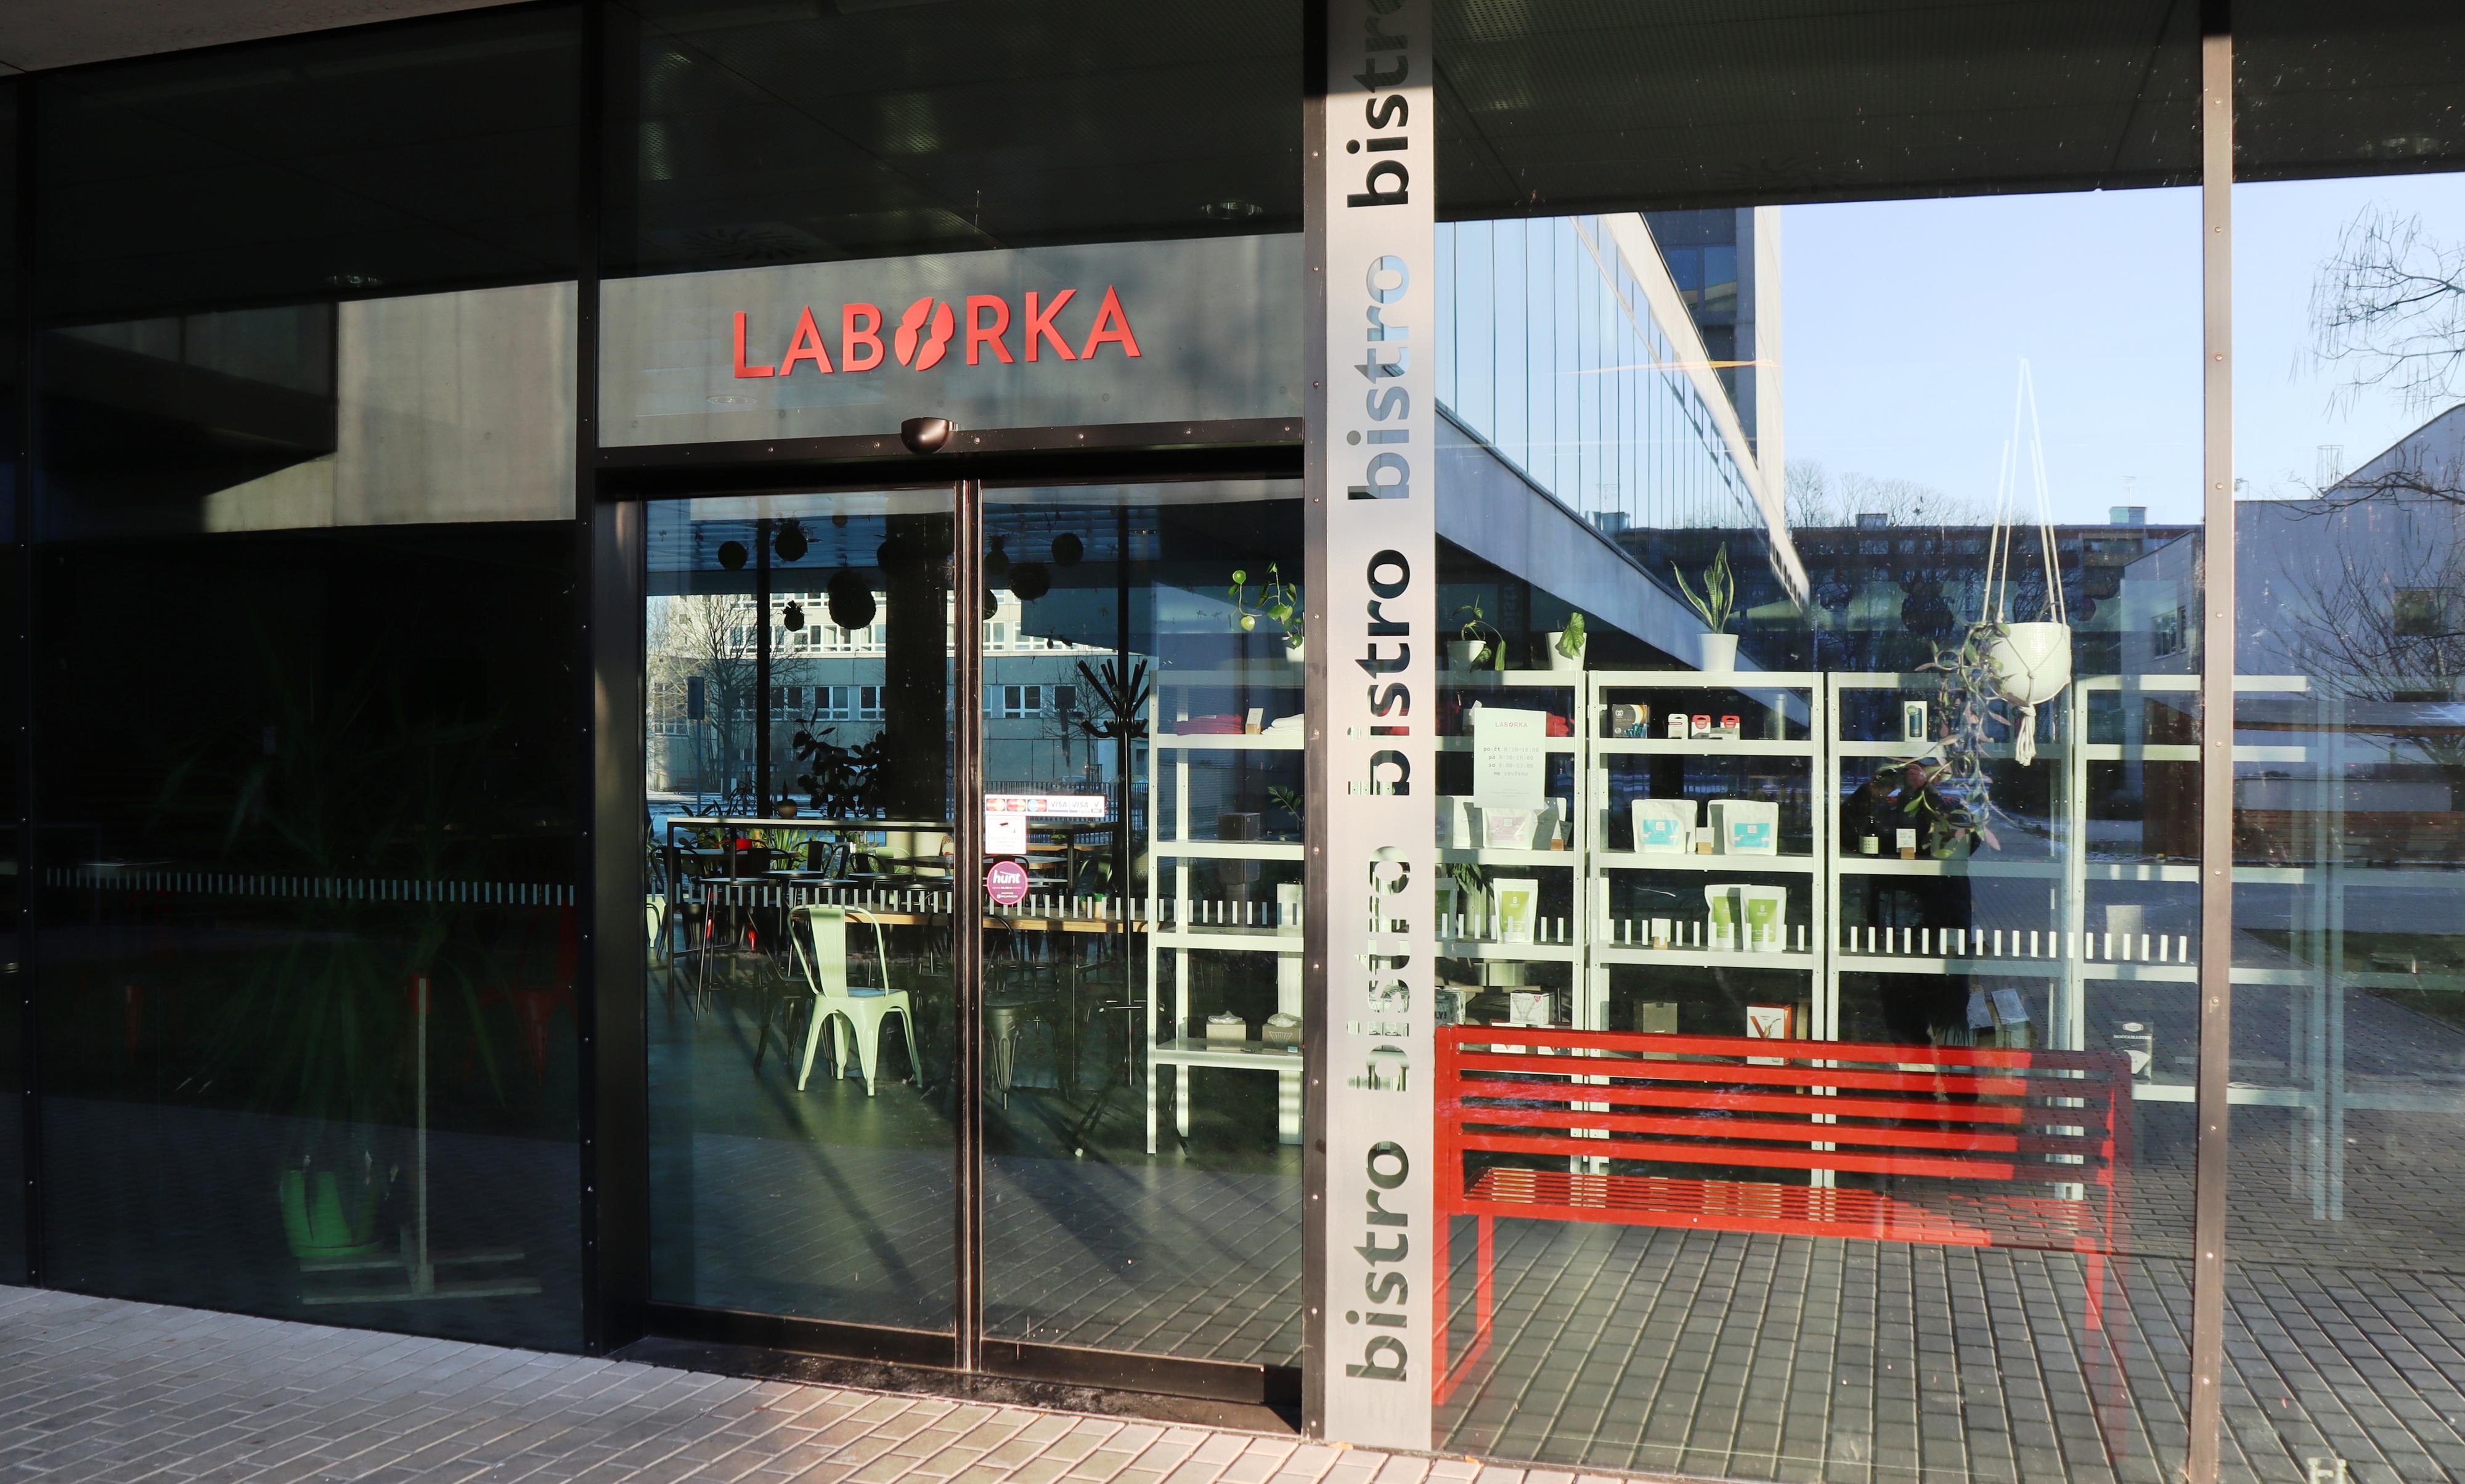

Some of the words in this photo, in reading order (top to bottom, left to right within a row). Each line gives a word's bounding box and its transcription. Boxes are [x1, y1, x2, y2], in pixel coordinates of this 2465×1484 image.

[1347, 0, 1411, 208] bistr
[733, 285, 1141, 378] LABORKA
[1347, 255, 1411, 500] bistro
[1347, 549, 1411, 796] bistro
[993, 869, 1021, 884] hunt
[1347, 846, 1411, 1092] bistro
[1345, 1140, 1409, 1382] bistro
